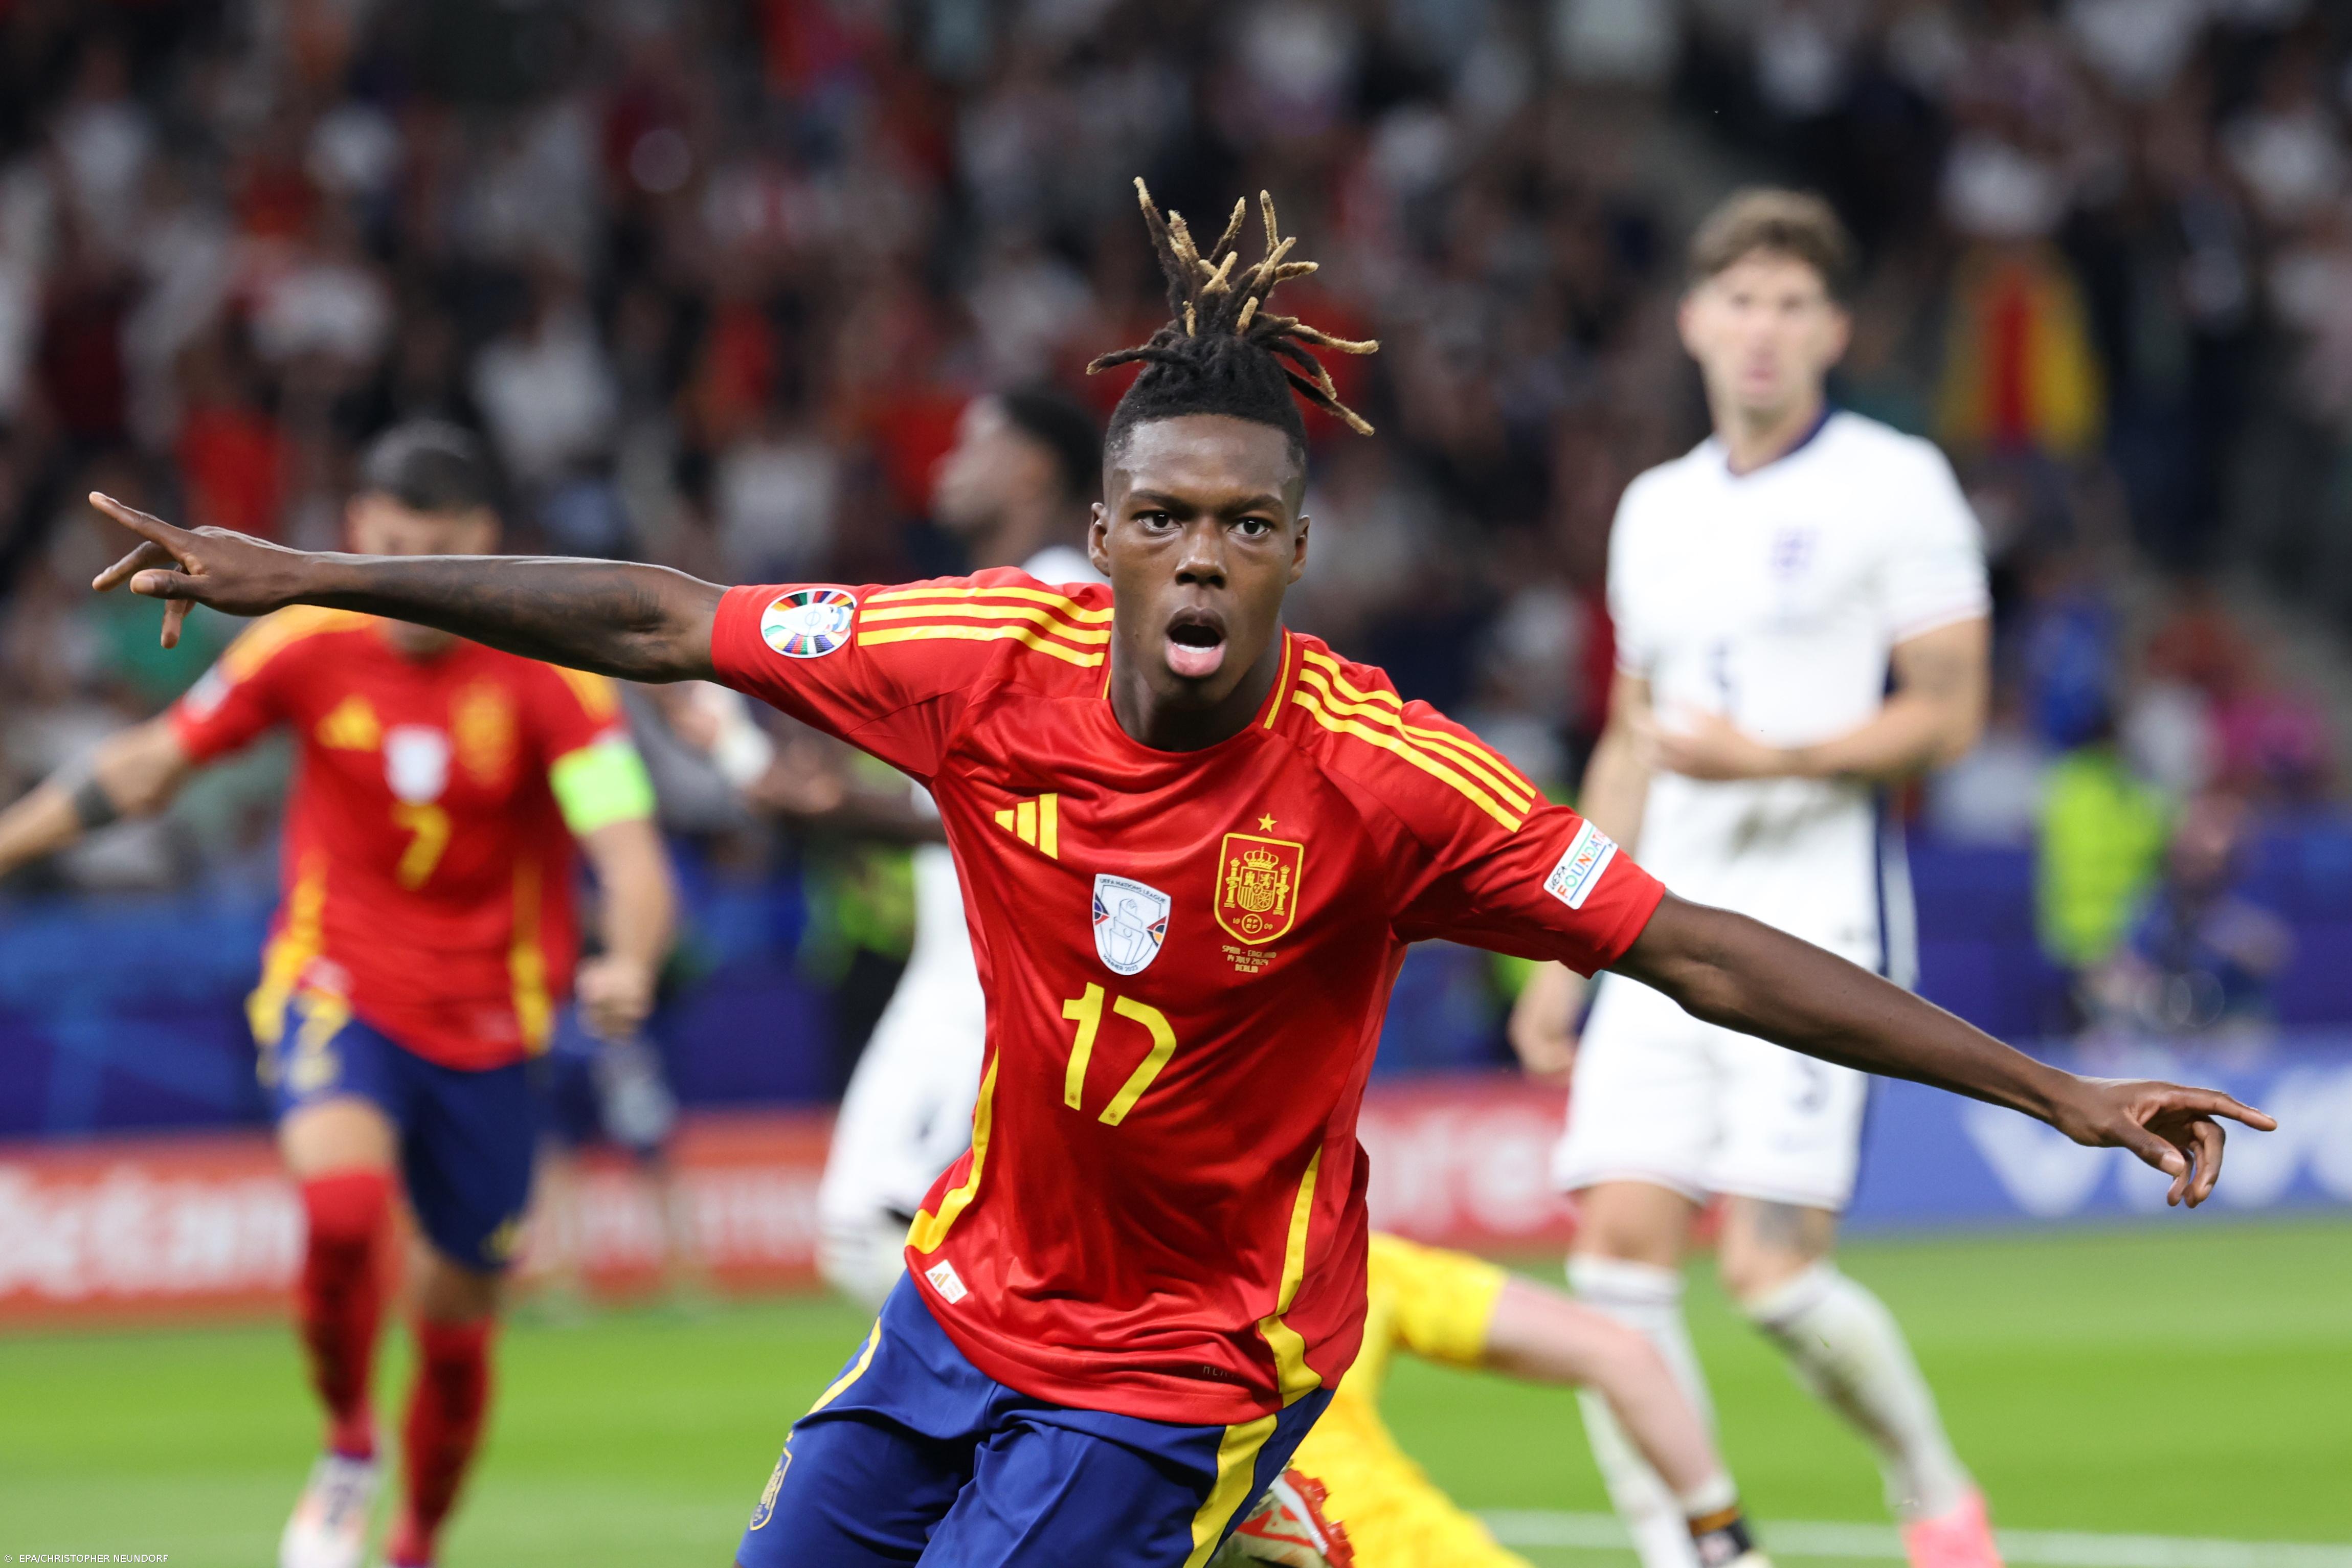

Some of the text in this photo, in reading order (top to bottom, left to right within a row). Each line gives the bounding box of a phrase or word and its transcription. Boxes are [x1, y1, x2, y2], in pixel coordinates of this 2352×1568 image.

[1116, 881, 1141, 892] NATIONS
[1143, 889, 1167, 903] LEAGUE
[1103, 953, 1123, 970] WINNER
[1062, 982, 1177, 1126] 17
